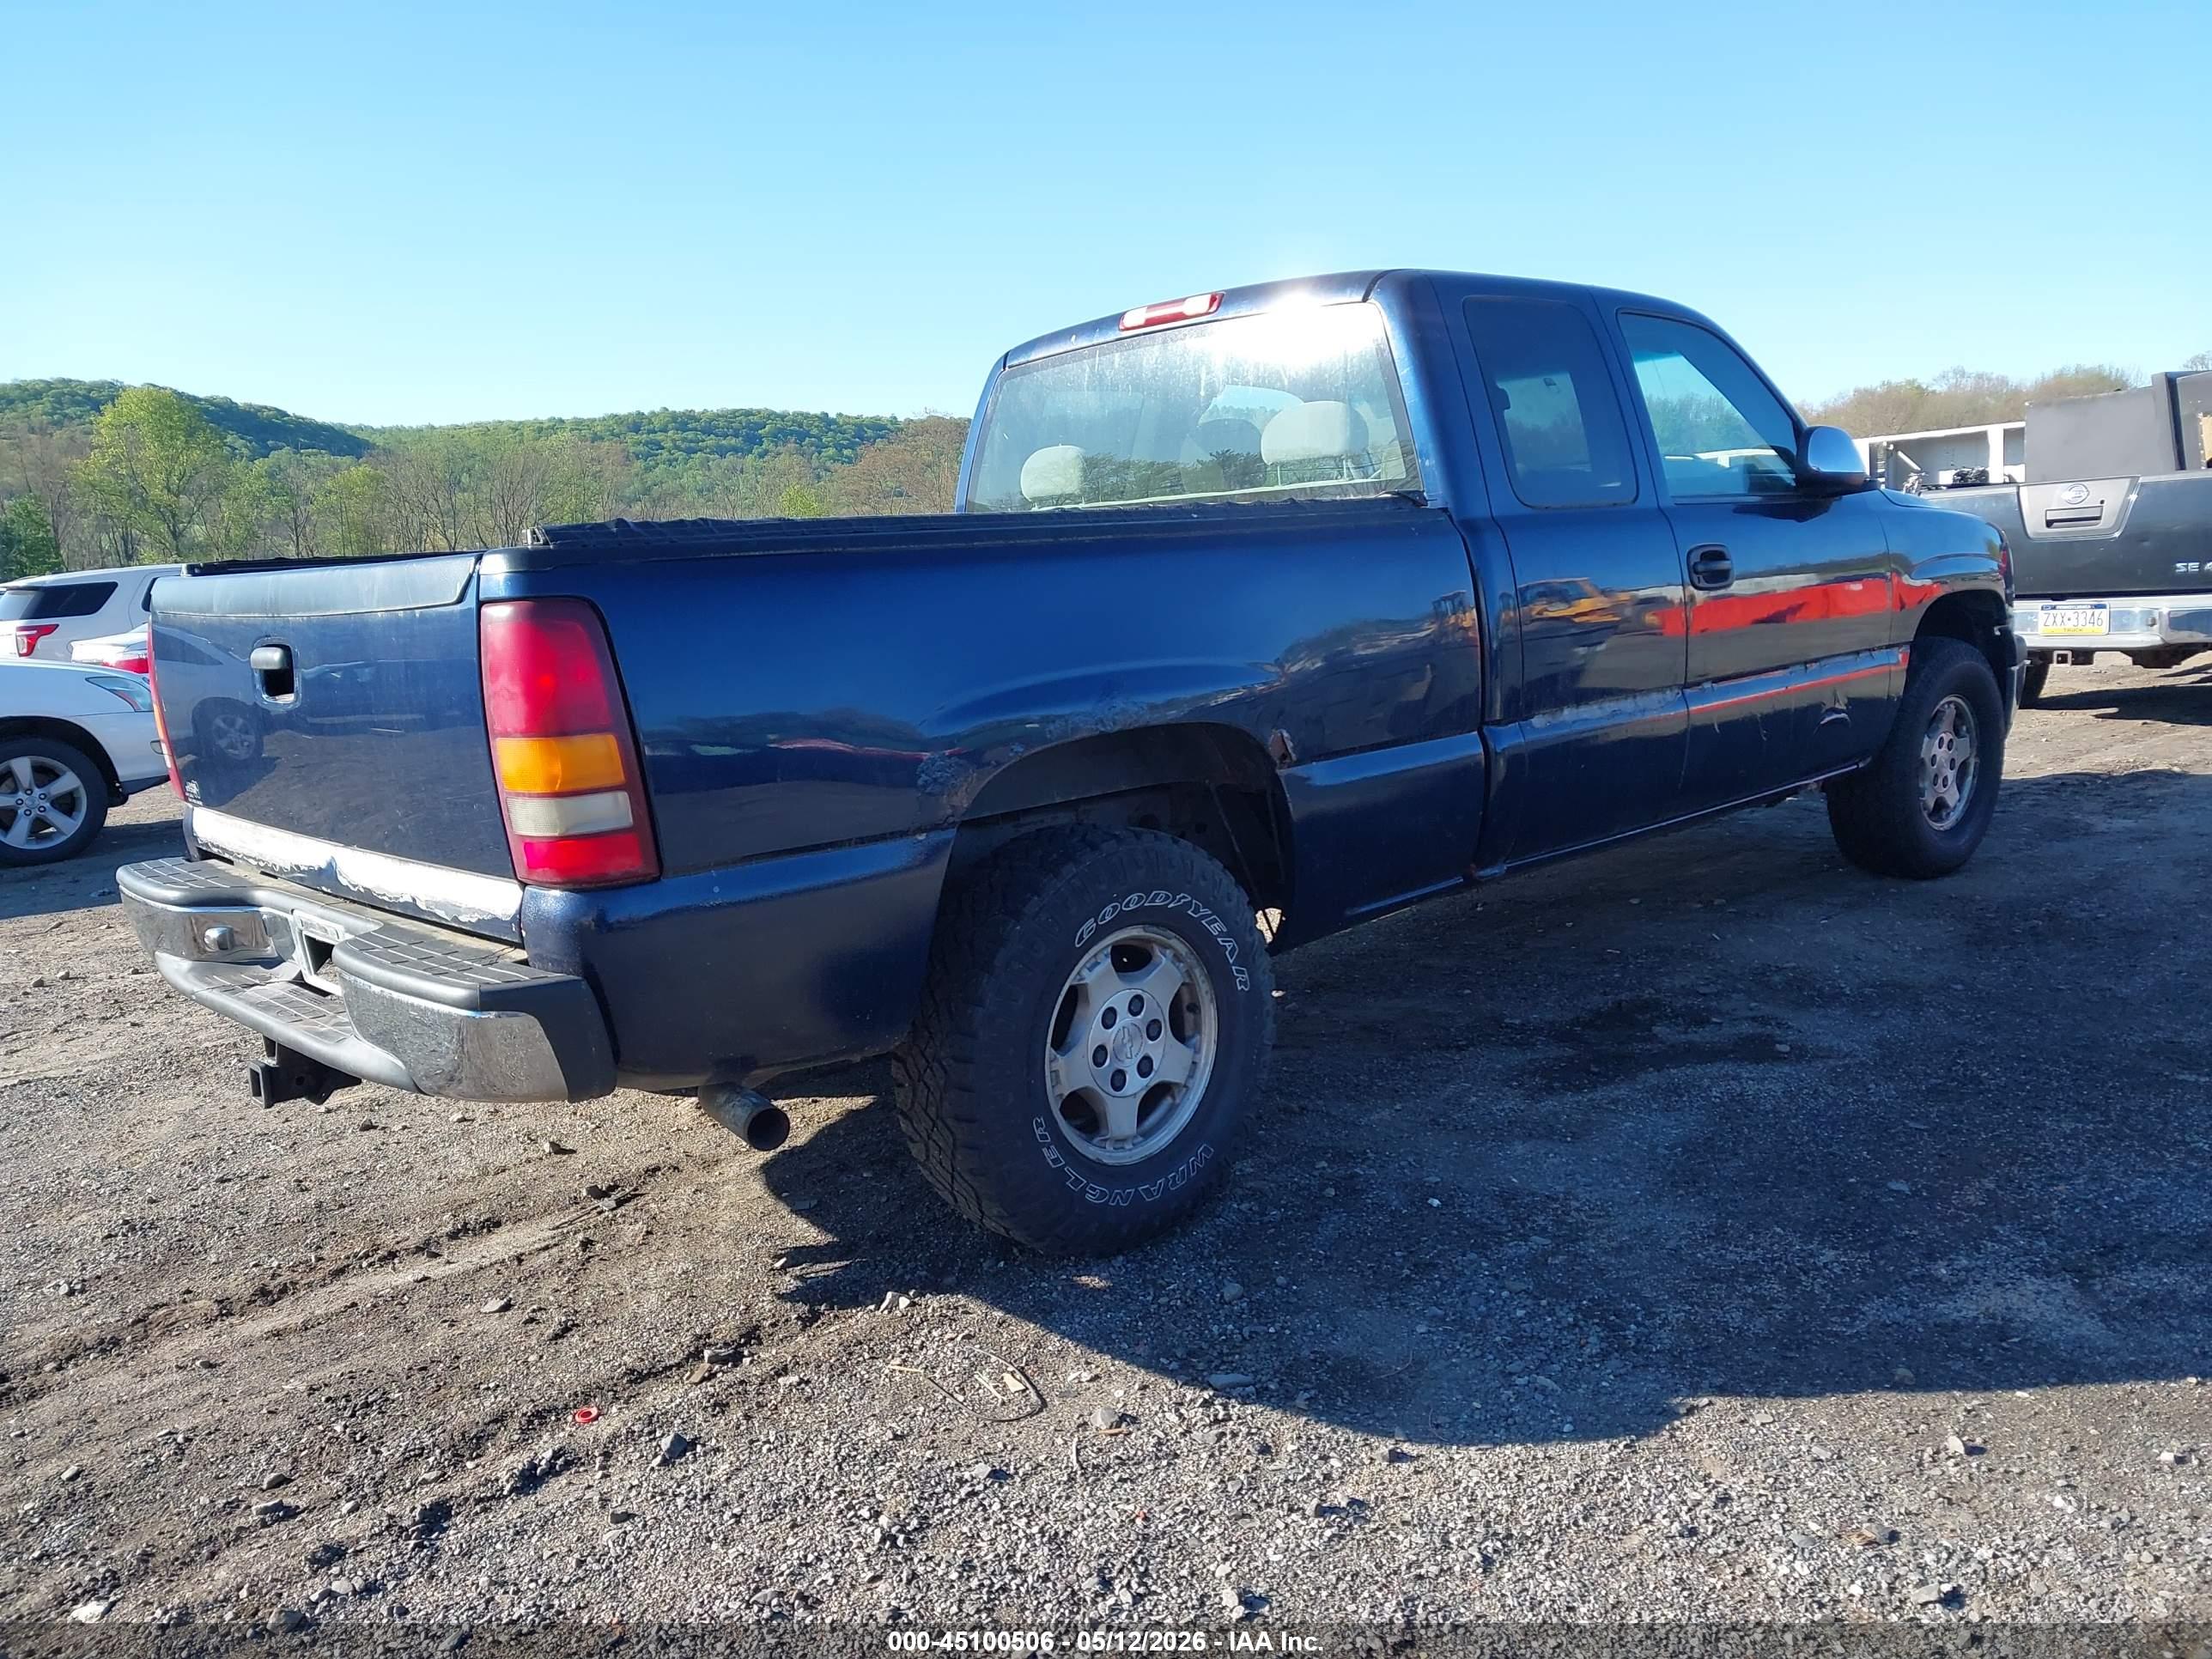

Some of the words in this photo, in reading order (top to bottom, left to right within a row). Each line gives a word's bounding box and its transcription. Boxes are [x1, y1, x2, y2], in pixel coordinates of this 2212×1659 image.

[2175, 562, 2200, 572] SE
[1075, 890, 1250, 992] GOODYEAR
[1033, 1115, 1214, 1206] WRANGLER
